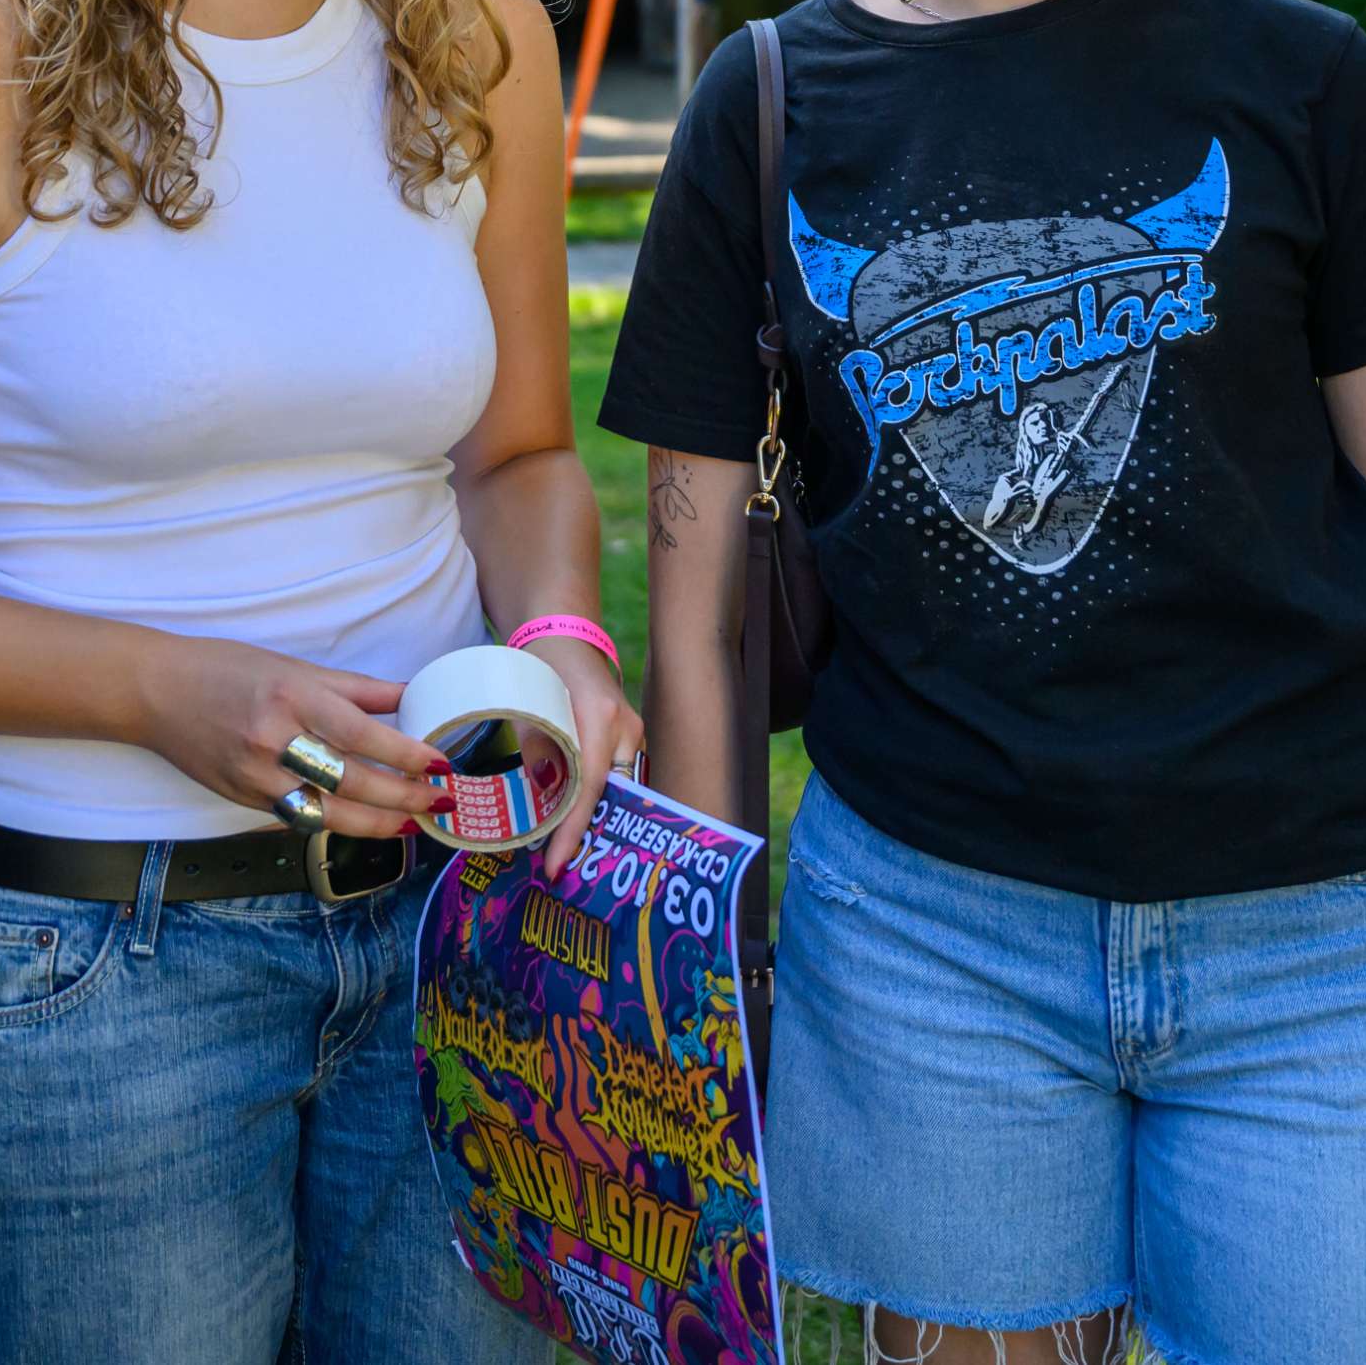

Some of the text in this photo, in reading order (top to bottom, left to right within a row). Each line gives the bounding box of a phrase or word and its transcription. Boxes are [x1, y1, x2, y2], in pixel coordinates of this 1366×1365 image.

[839, 263, 1217, 479] Rockpalast
[454, 781, 495, 794] tesa
[456, 792, 497, 805] tesa
[457, 803, 498, 816] tesa
[459, 814, 500, 827] tesa
[459, 826, 502, 838] tesa
[604, 804, 730, 883] CD-KASERNE
[459, 866, 491, 892] JETZT
[466, 1102, 700, 1291] DUST BOLT
[550, 1262, 582, 1290] CITY
